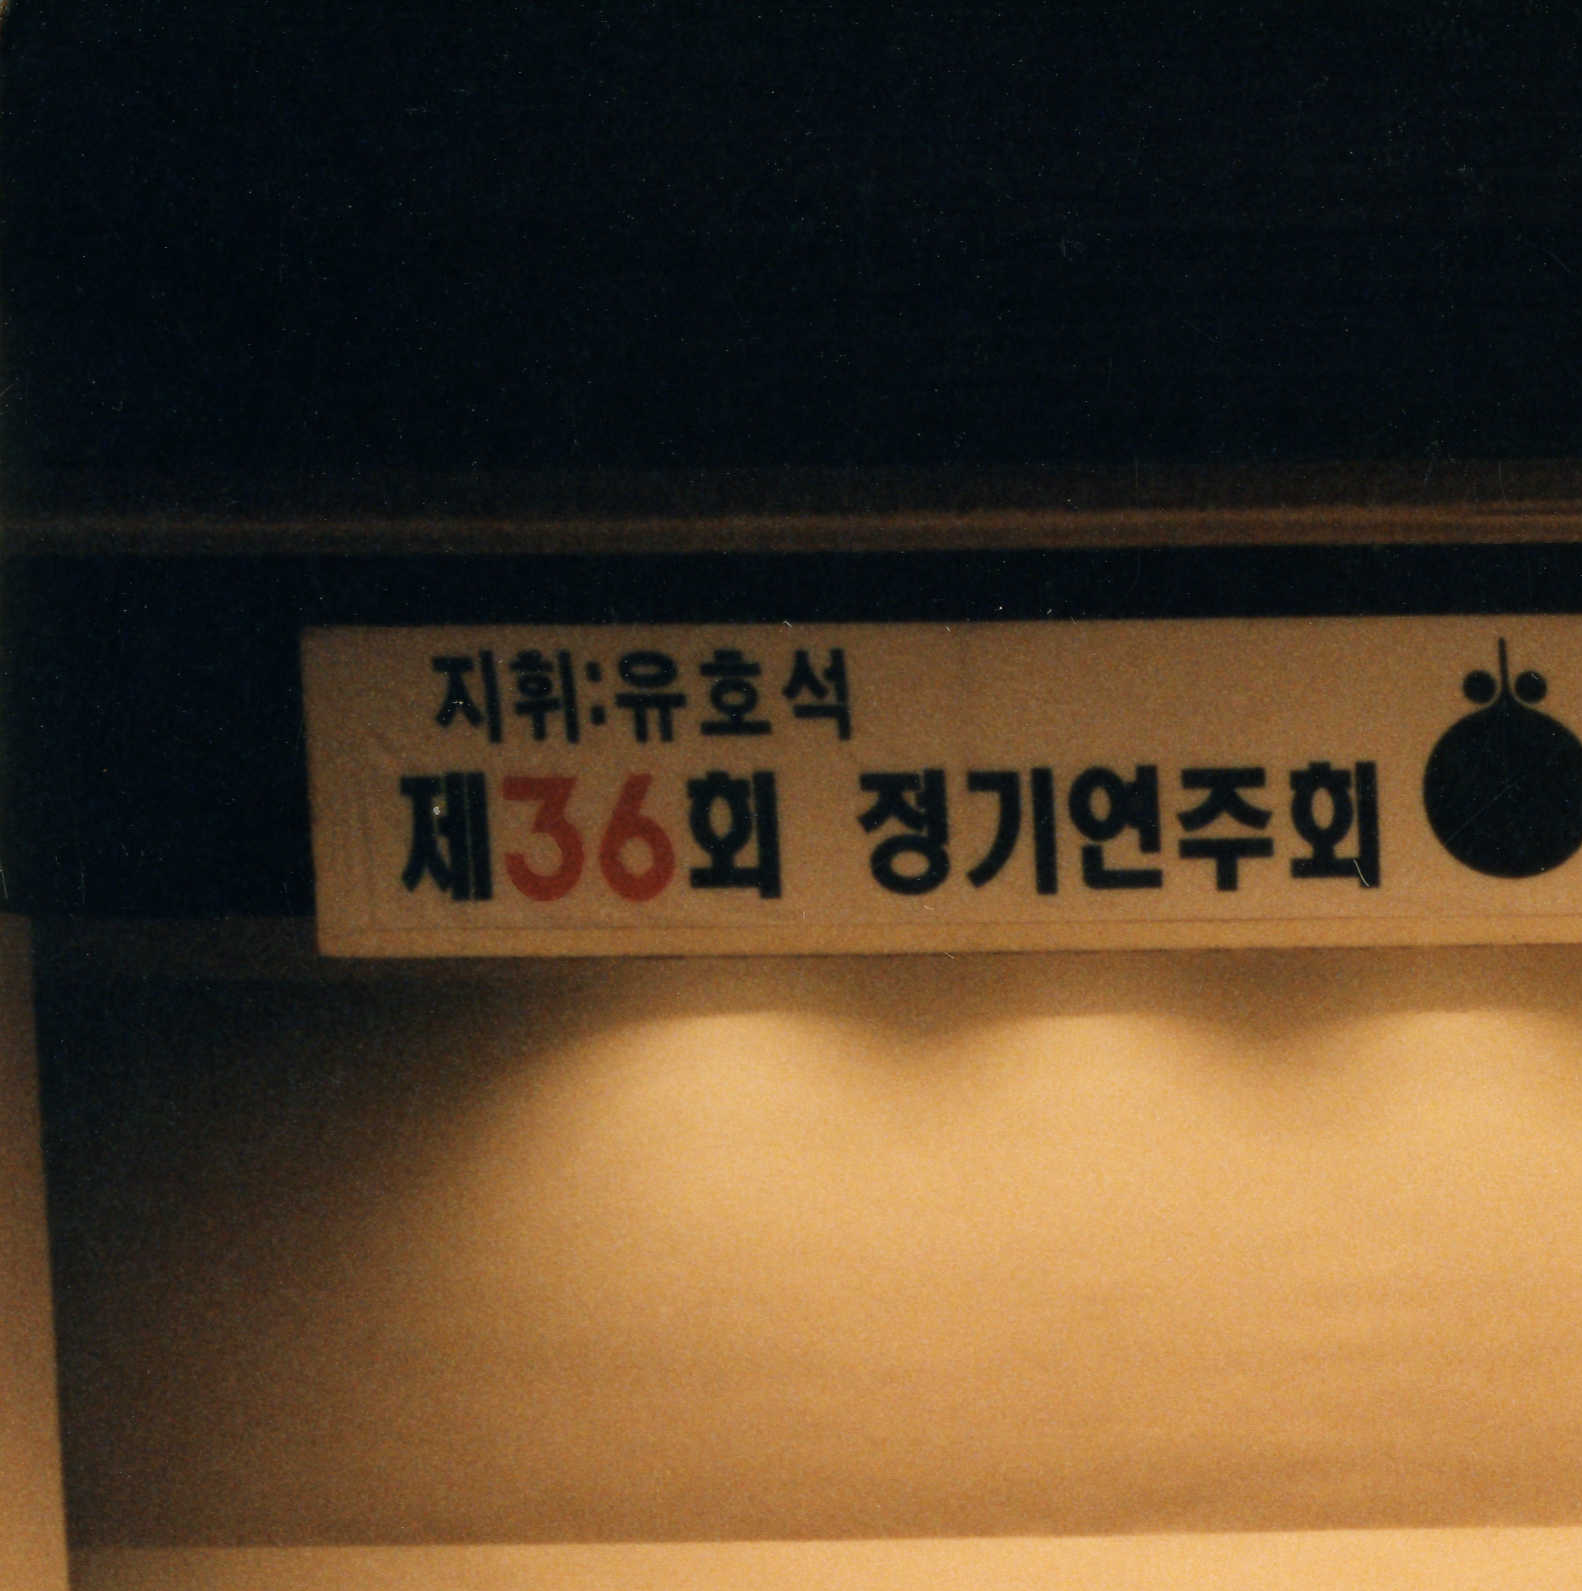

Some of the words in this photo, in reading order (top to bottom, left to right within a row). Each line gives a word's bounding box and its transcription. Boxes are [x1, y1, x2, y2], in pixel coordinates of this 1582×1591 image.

[430, 647, 851, 744] 지휘:유호석
[399, 770, 782, 903] 제36회
[857, 760, 1380, 896] 정기연주회
